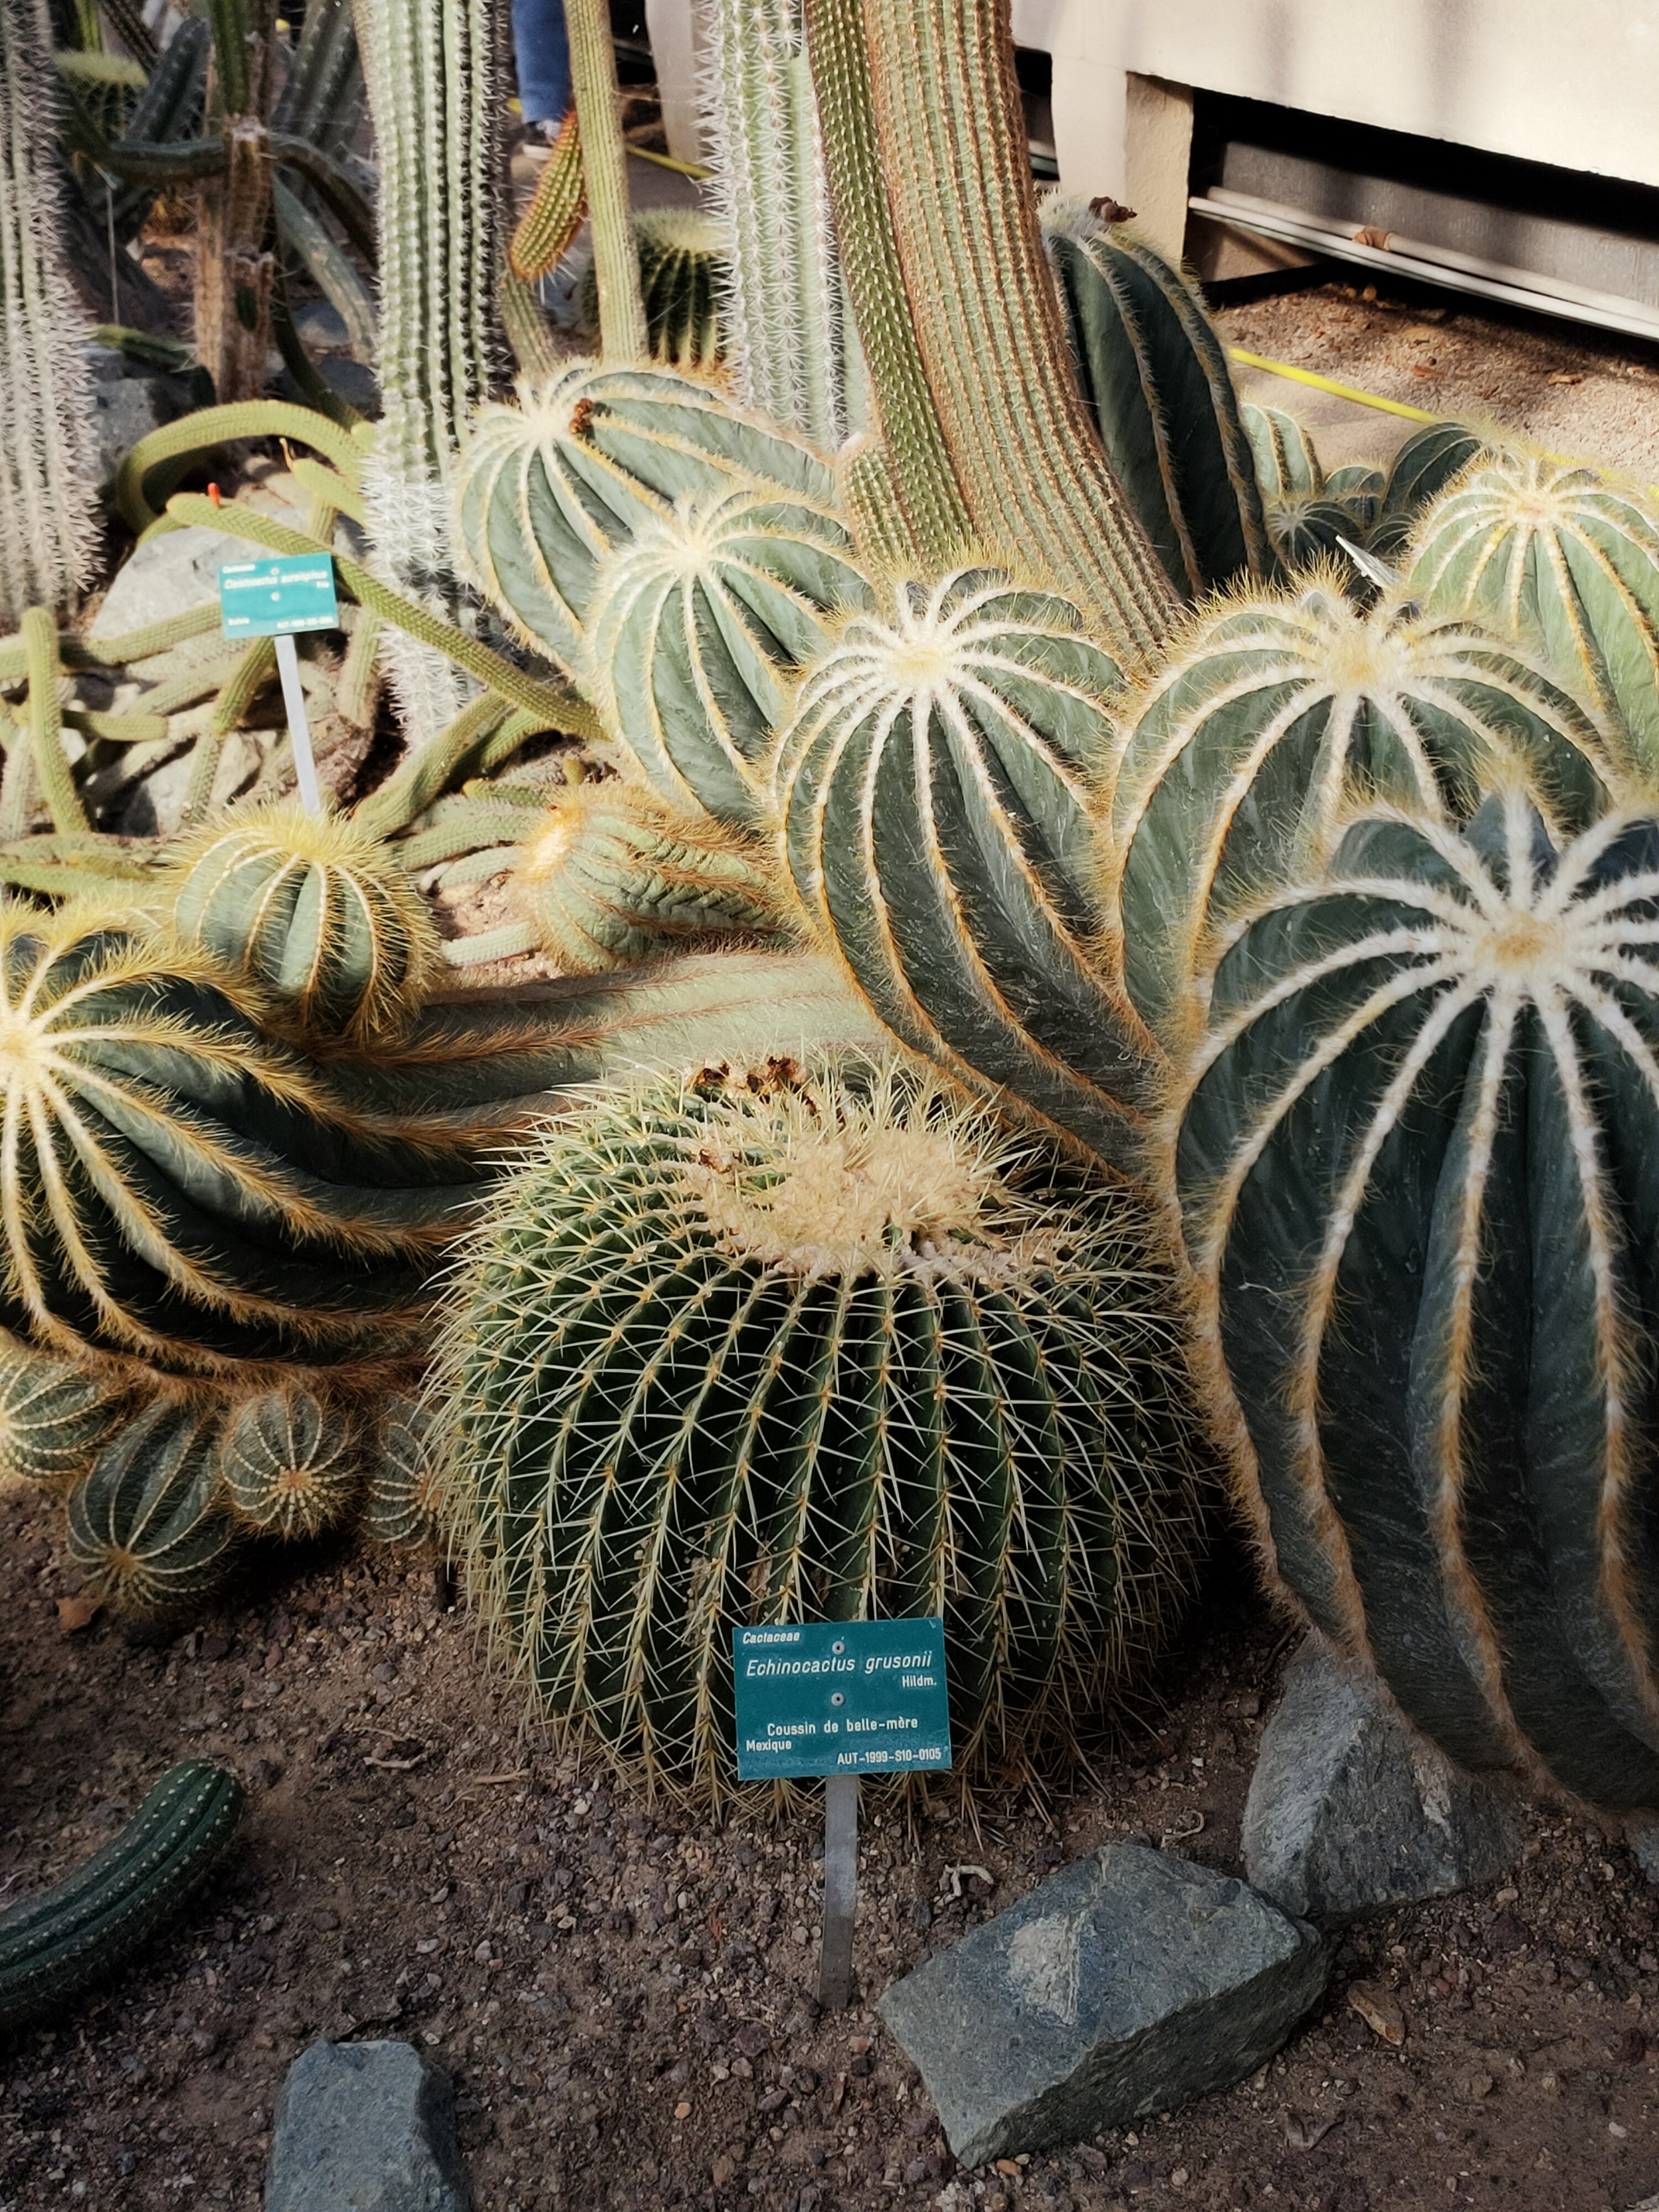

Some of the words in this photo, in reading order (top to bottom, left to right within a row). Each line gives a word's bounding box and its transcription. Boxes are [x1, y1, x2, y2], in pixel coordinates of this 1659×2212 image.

[742, 1631, 800, 1644] Cactaceae
[747, 1657, 855, 1677] Echinocactus
[864, 1650, 932, 1674] grusonii
[901, 1674, 937, 1688] Hildm.
[767, 1720, 816, 1736] Coussin
[823, 1719, 839, 1733] de
[846, 1716, 919, 1732] belle-mère
[746, 1739, 792, 1753] Mexique
[837, 1747, 942, 1765] AUT-1999-S10-0105
